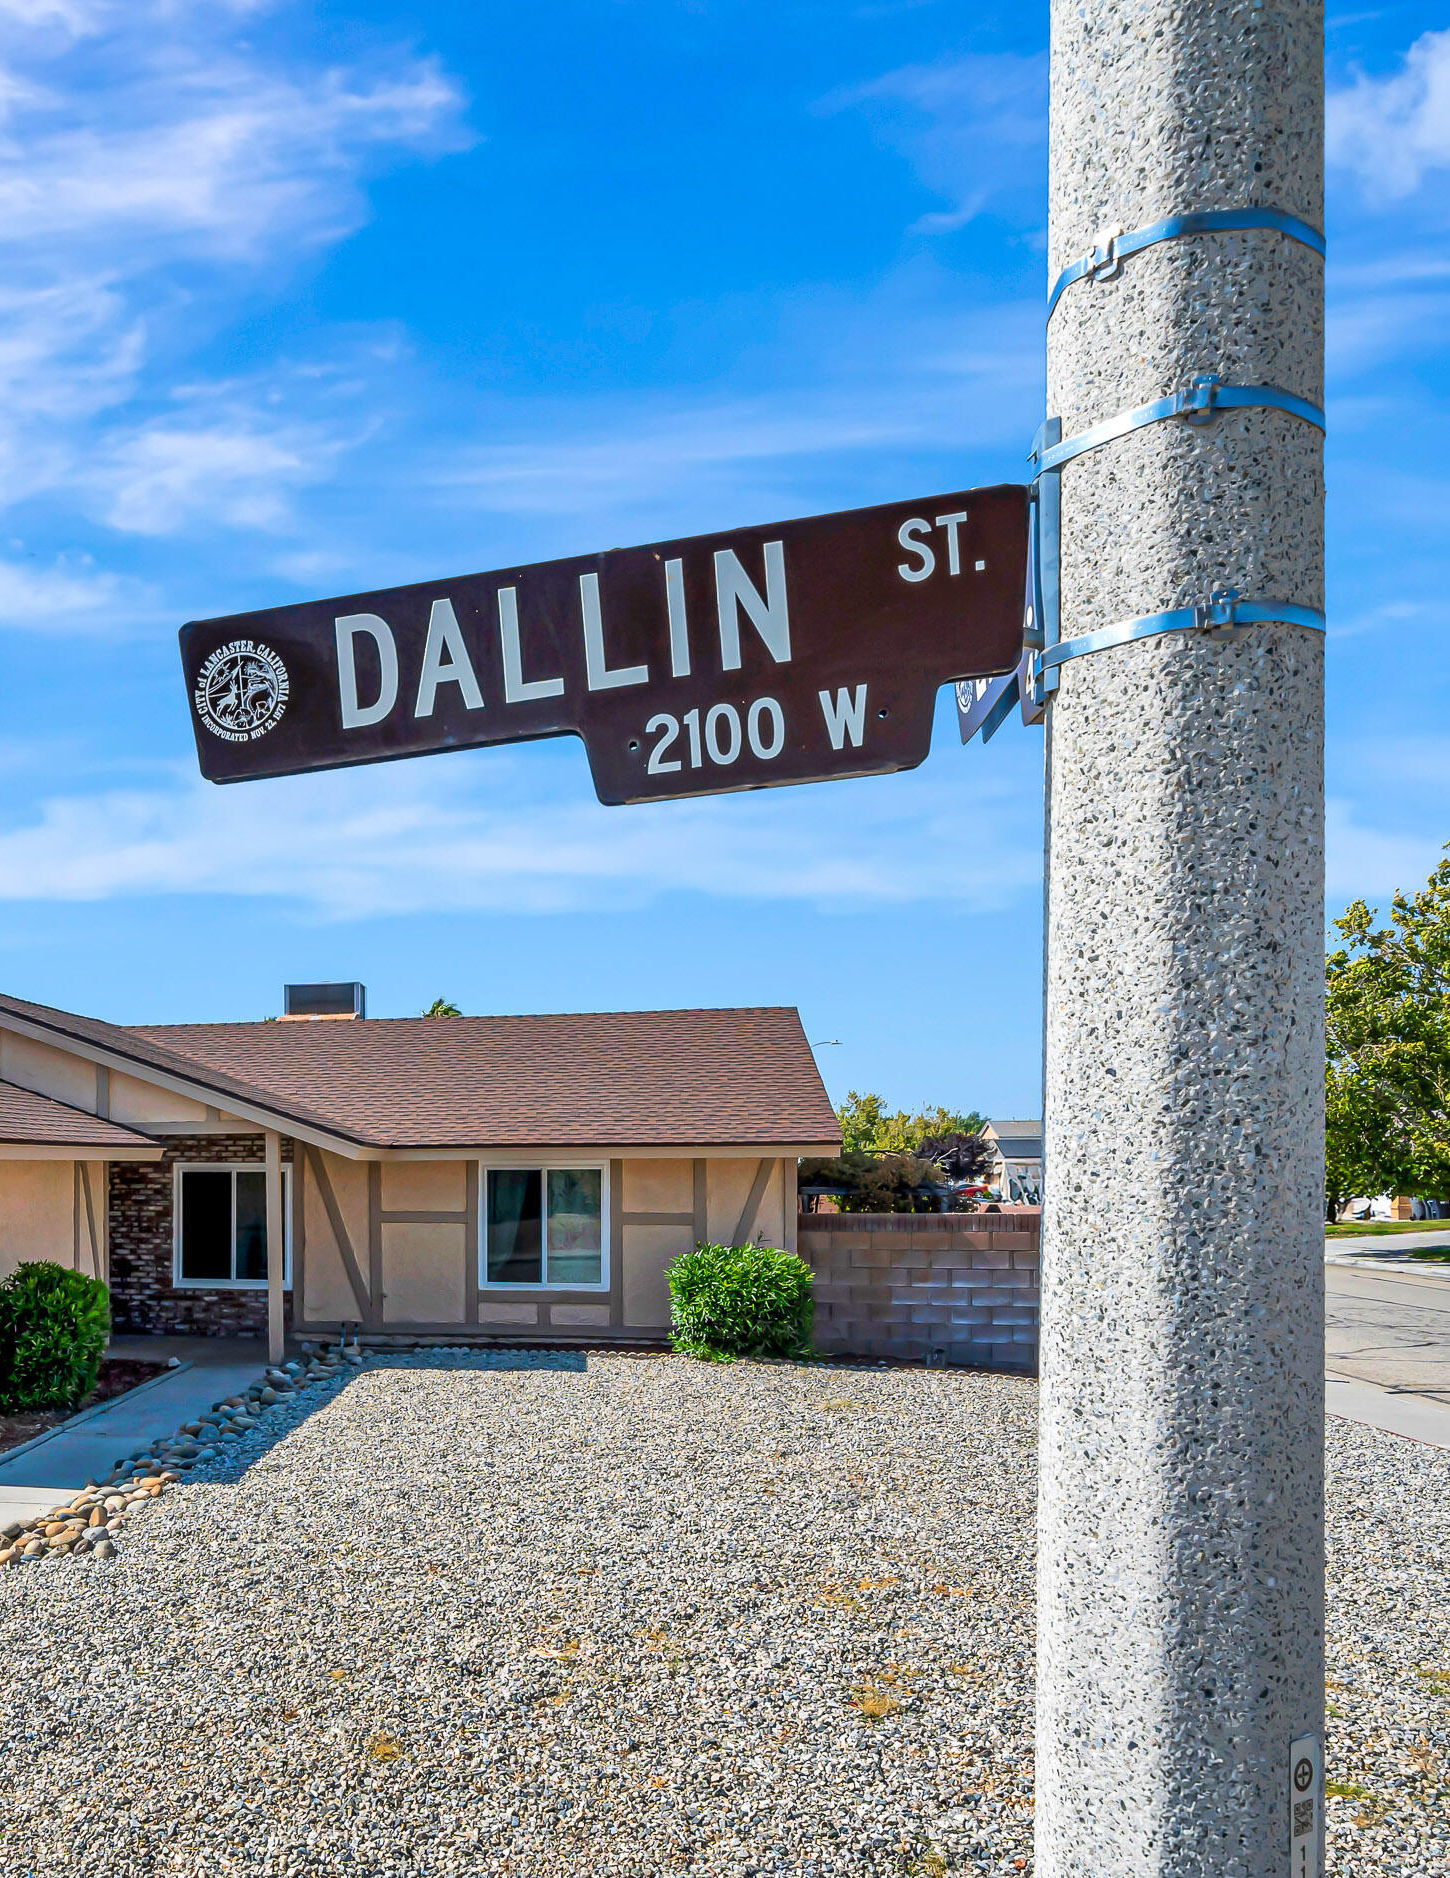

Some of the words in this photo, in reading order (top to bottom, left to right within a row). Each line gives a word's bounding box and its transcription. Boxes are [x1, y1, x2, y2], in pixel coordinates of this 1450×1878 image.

[335, 541, 792, 730] DALLIN
[897, 511, 986, 583] ST.
[200, 640, 256, 677] LANCASTER,
[256, 644, 289, 701] CALIFORNIA
[197, 677, 207, 688] of
[195, 690, 208, 714] CITY
[201, 715, 249, 741] INCORPORATED
[250, 726, 267, 740] NOV.
[273, 703, 286, 720] 1977
[645, 696, 785, 775] 2100
[818, 683, 868, 751] W
